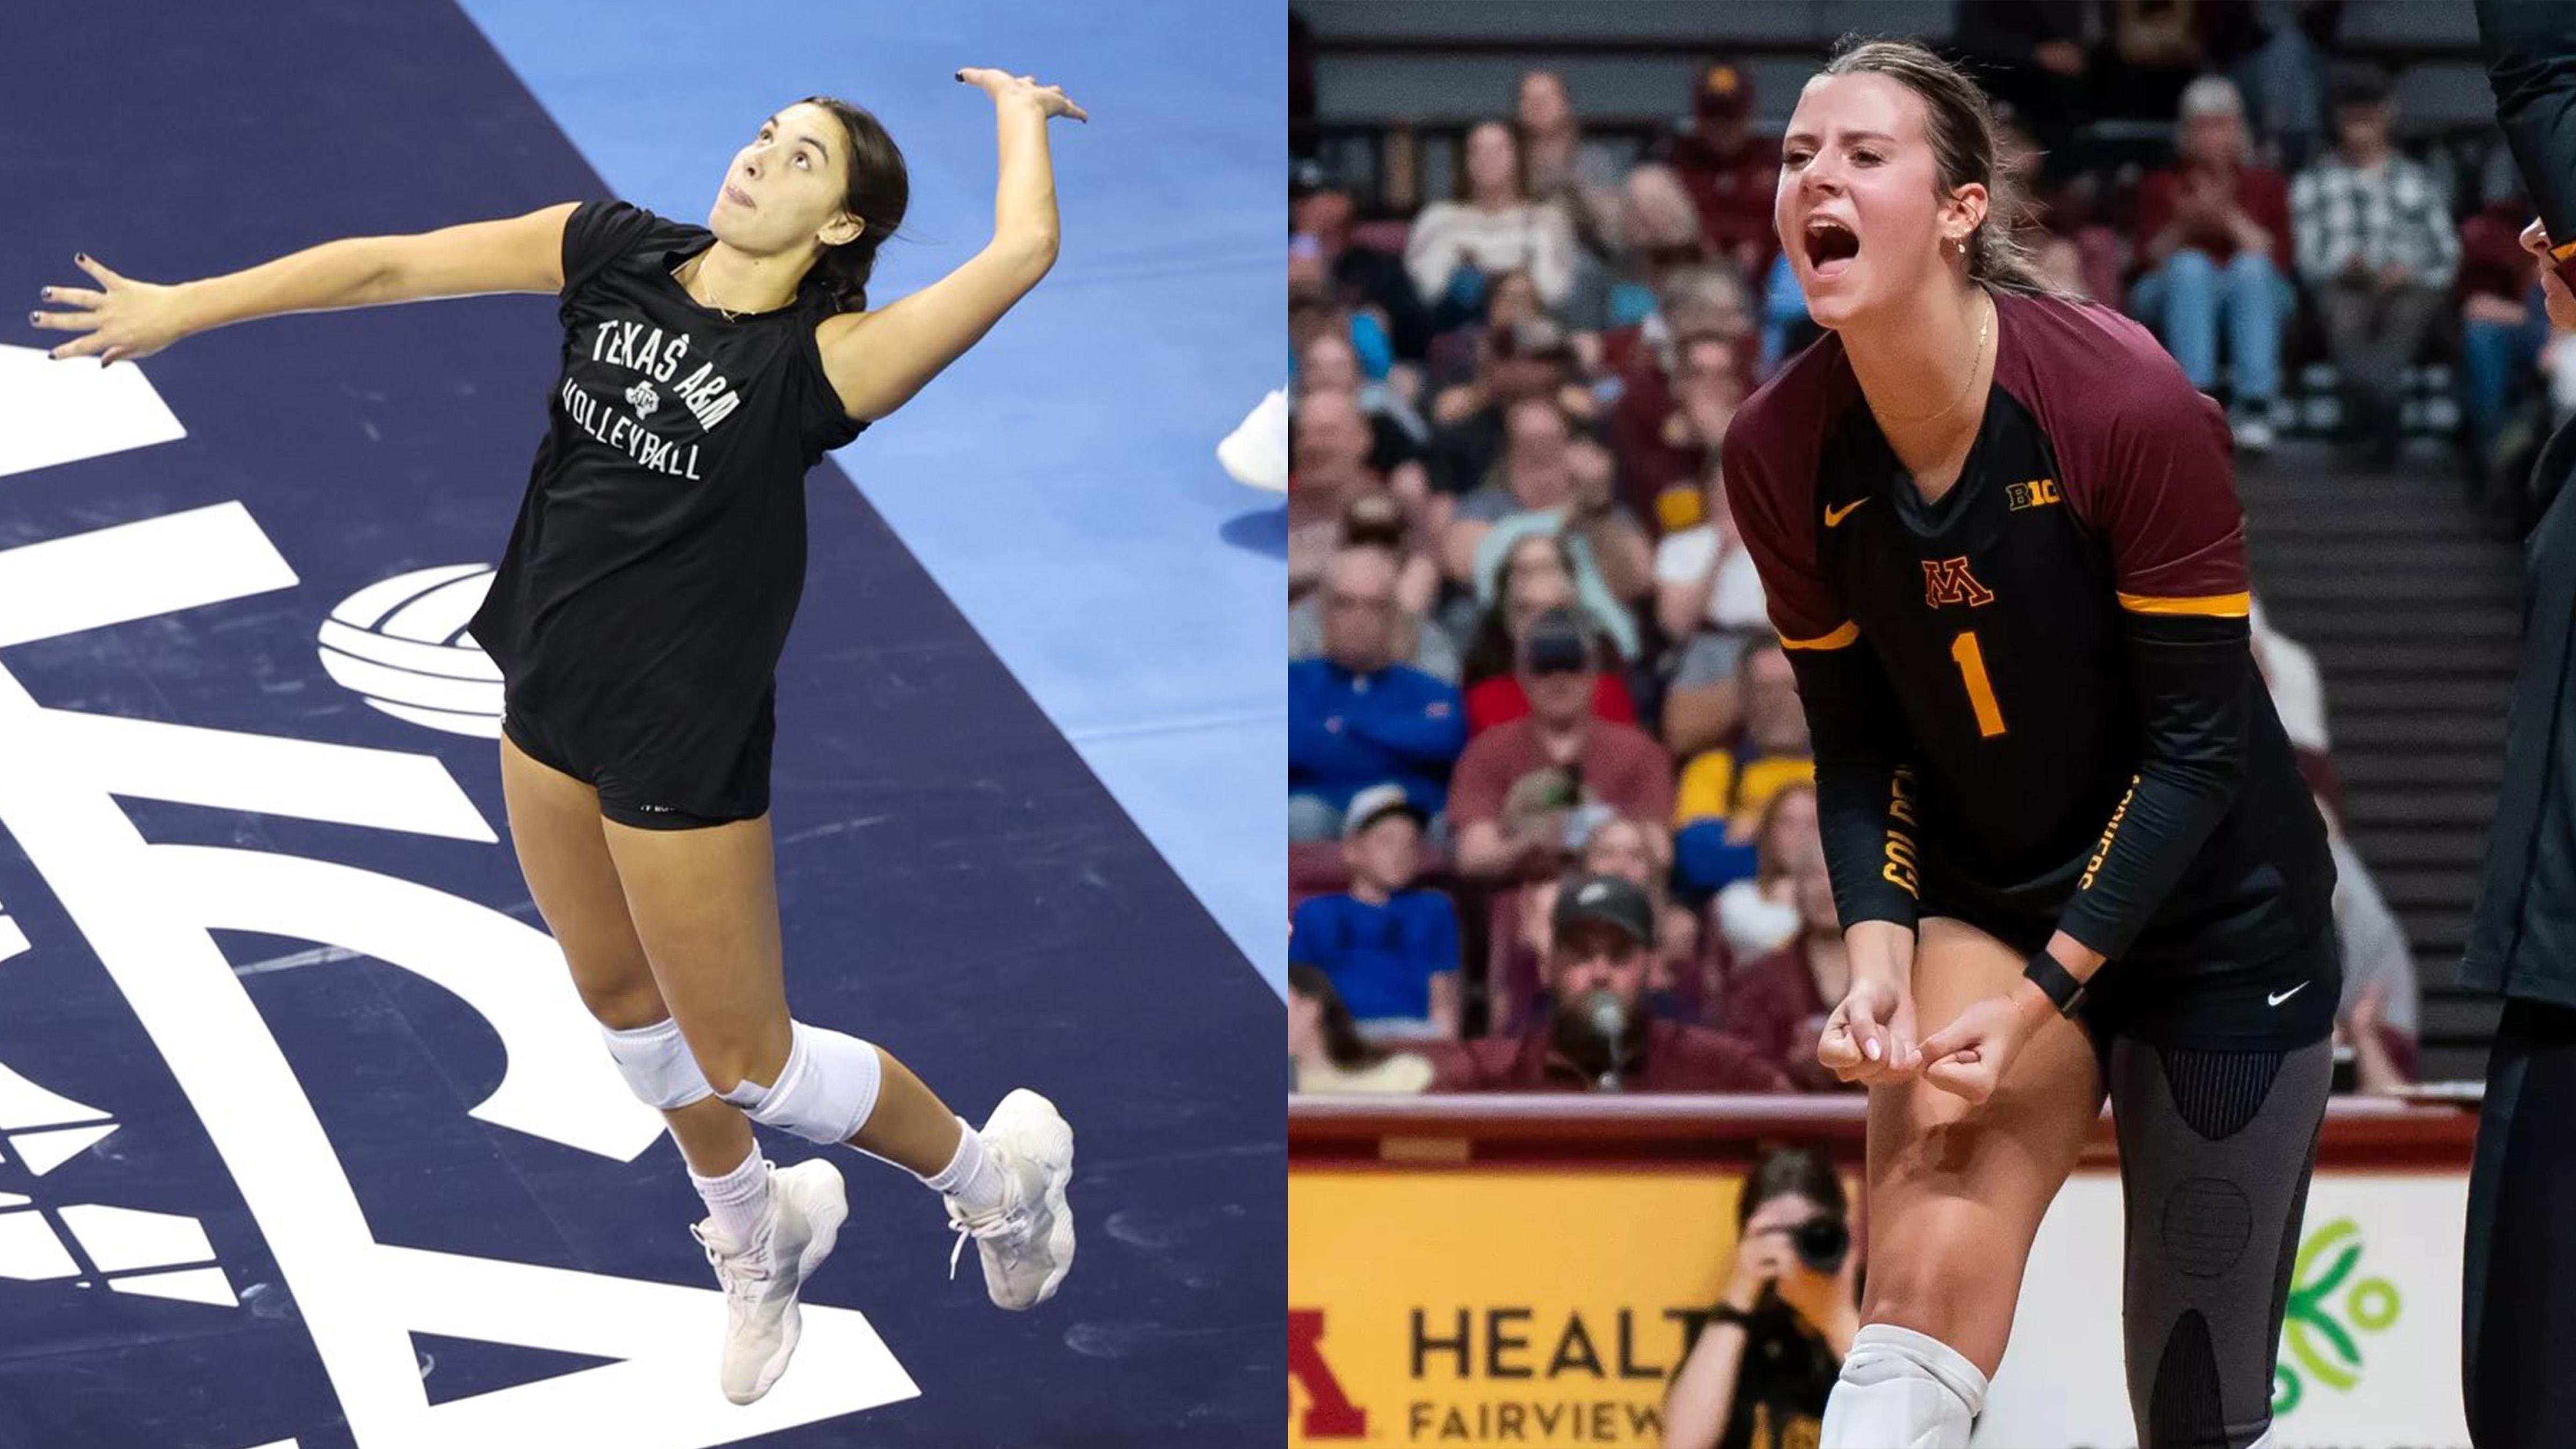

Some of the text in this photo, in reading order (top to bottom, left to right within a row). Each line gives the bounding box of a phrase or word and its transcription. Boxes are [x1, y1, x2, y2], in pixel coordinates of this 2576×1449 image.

[592, 320, 741, 433] TEXAS A&M
[562, 377, 700, 480] VOLLEYBALL
[1921, 556, 1995, 609] M
[1951, 631, 2007, 737] 1
[1410, 1308, 1715, 1378] HEALT
[1409, 1402, 1664, 1439] FAIRVIEW
